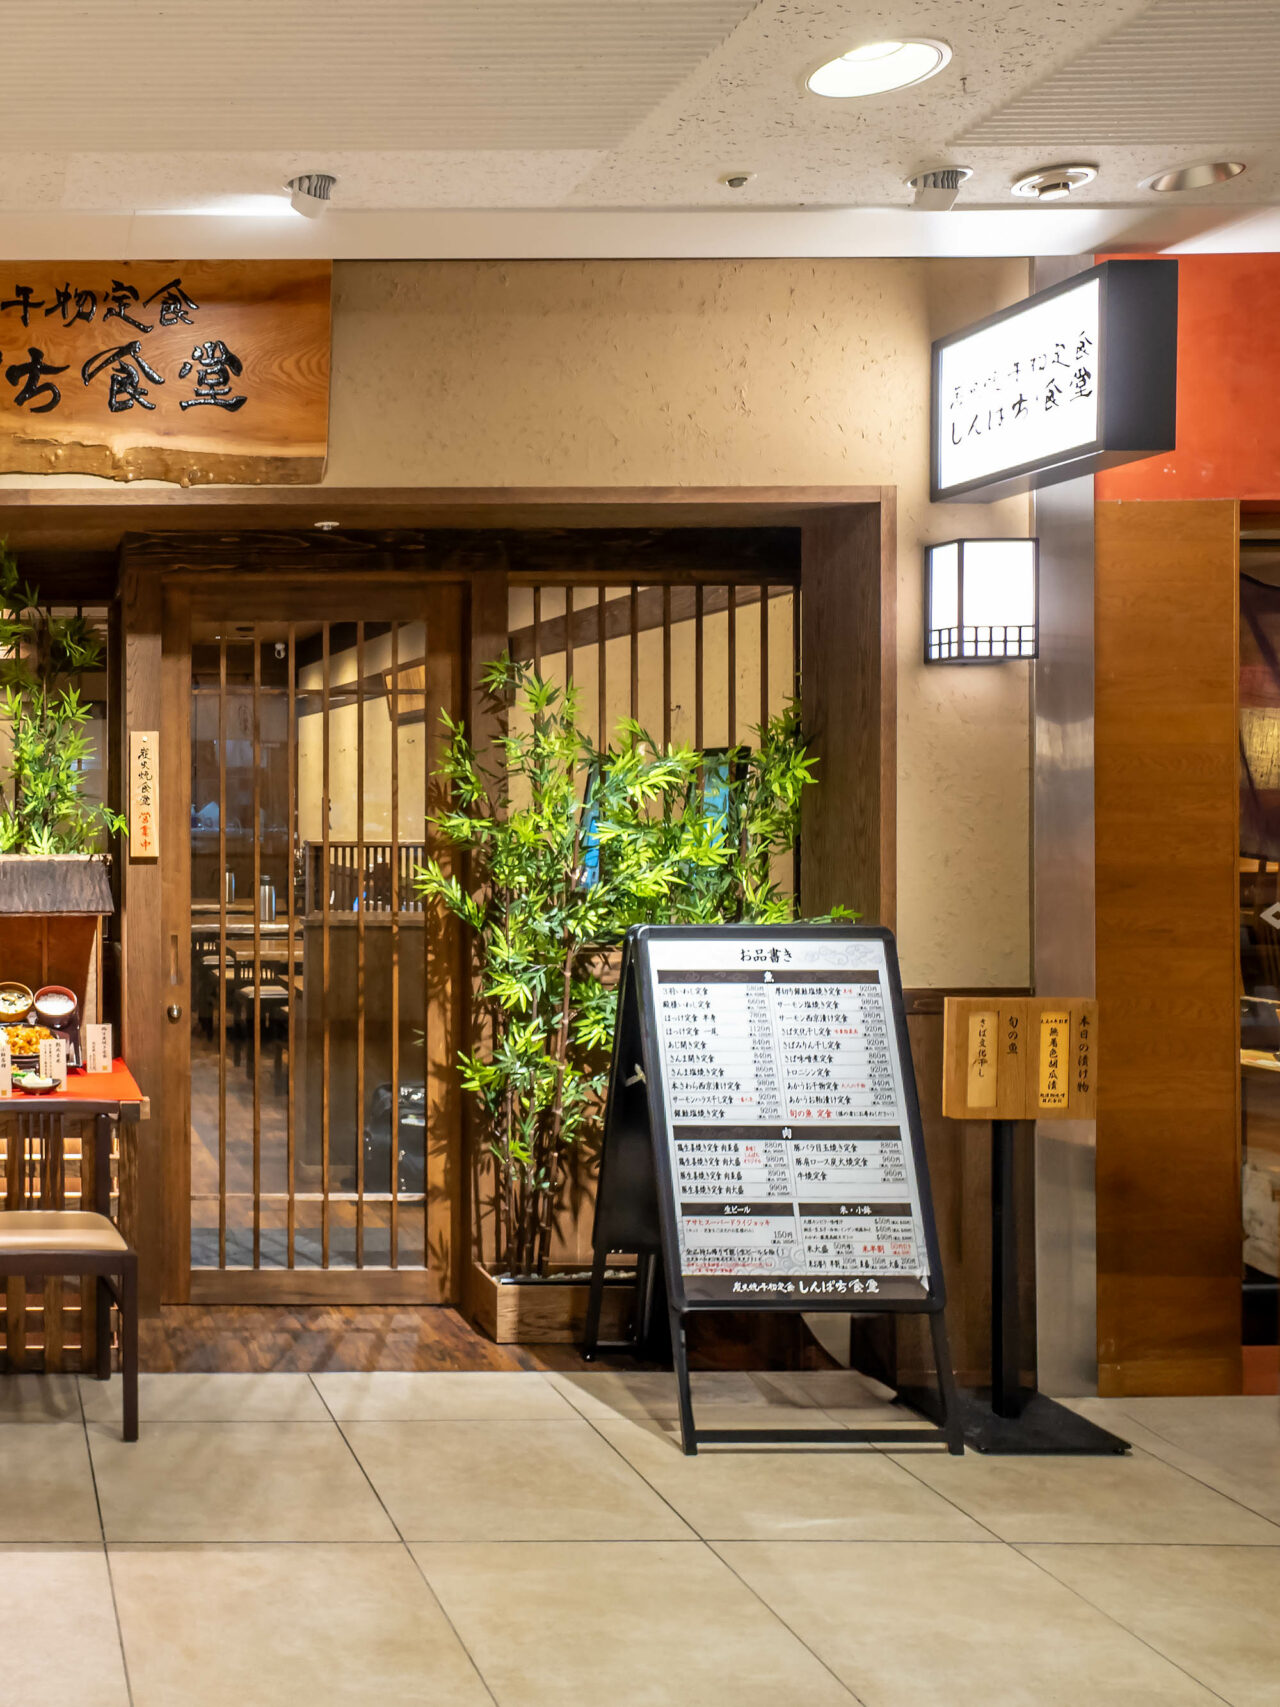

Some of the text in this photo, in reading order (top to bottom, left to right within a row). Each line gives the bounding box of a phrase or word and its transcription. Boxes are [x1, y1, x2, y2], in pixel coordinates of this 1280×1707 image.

[138, 812, 151, 851] 営業中
[741, 947, 792, 963] お品書き
[972, 1018, 988, 1078] さば文化干し
[1007, 1016, 1019, 1055] 旬の魚
[1077, 1016, 1090, 1093] 本日の漬け物
[817, 1108, 832, 1119] 定食
[724, 1205, 751, 1215] 生ビール
[799, 1279, 880, 1294] しんぱち食堂
